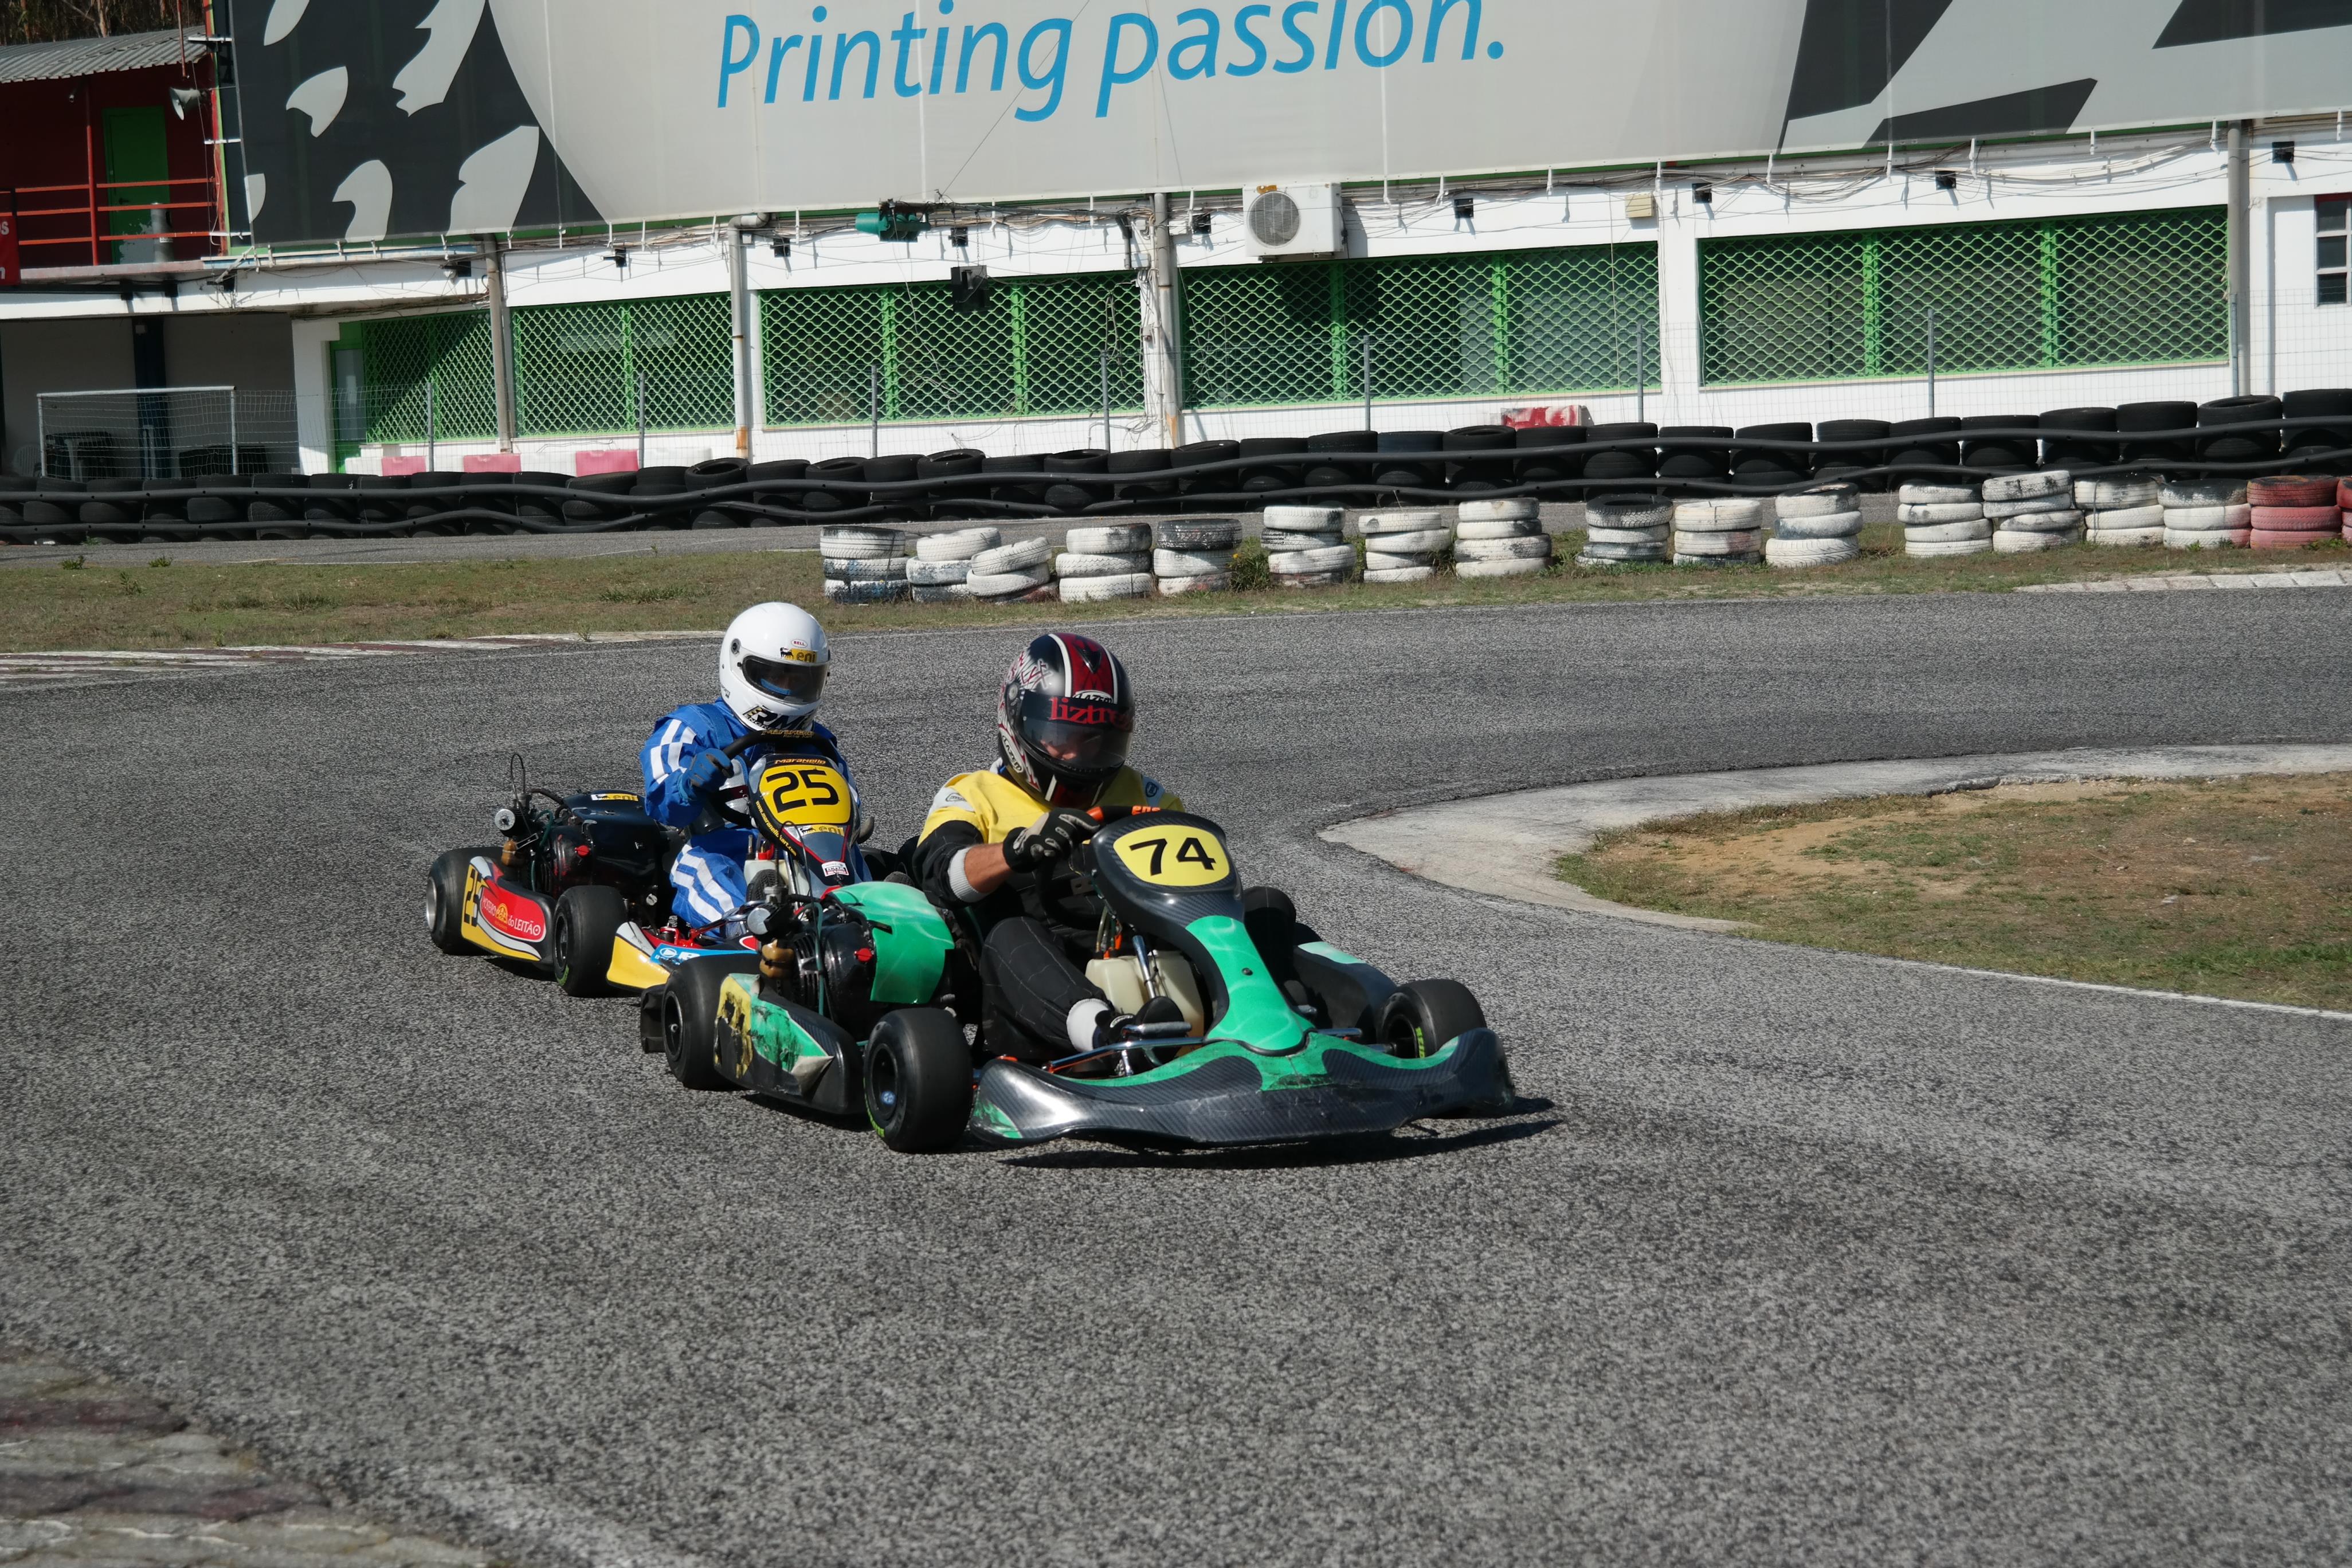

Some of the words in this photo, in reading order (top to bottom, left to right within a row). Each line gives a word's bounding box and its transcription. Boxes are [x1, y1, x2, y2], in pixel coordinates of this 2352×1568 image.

[718, 0, 1073, 121] Printing
[1095, 0, 1505, 118] passion.
[796, 651, 817, 663] eni
[766, 769, 840, 813] 25
[818, 825, 844, 836] eni
[1128, 837, 1217, 876] 74
[464, 868, 483, 927] 25
